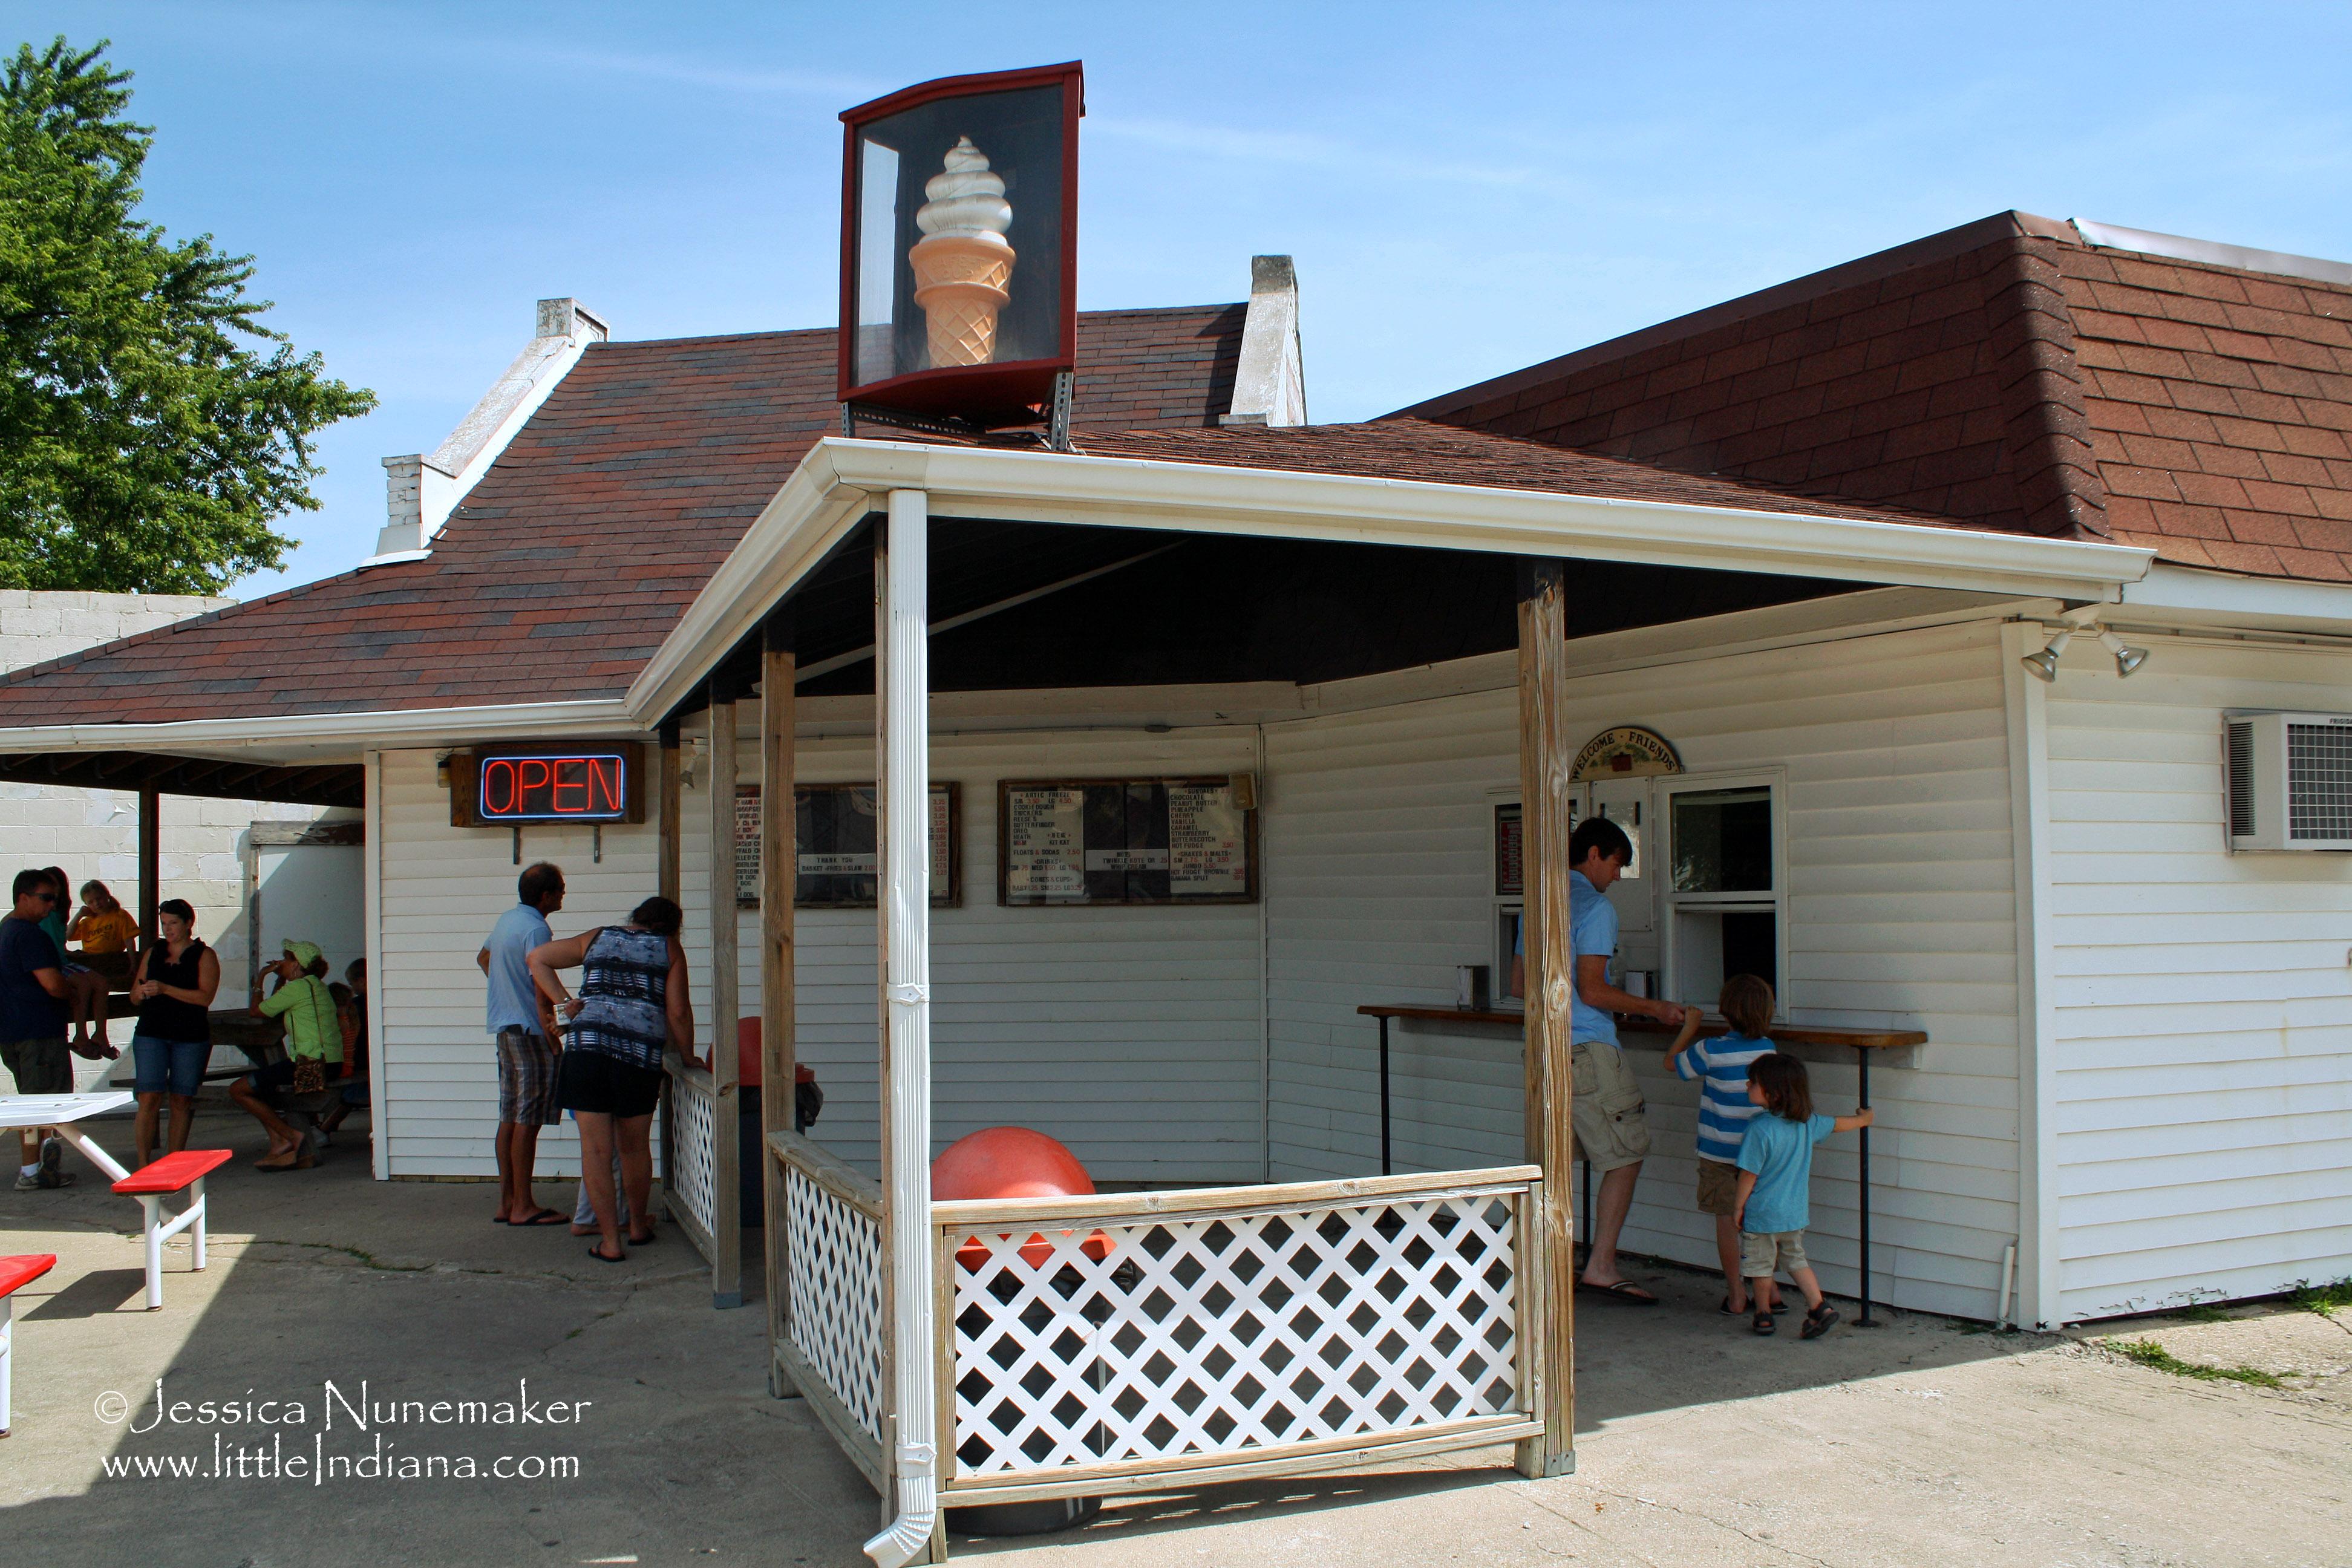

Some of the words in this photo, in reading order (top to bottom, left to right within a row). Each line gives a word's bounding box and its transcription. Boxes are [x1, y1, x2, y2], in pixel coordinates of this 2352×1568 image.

[942, 265, 973, 279] CUP
[1572, 733, 1615, 779] WELCOME
[1628, 731, 1675, 771] FRIENDS
[485, 758, 620, 813] OPEN
